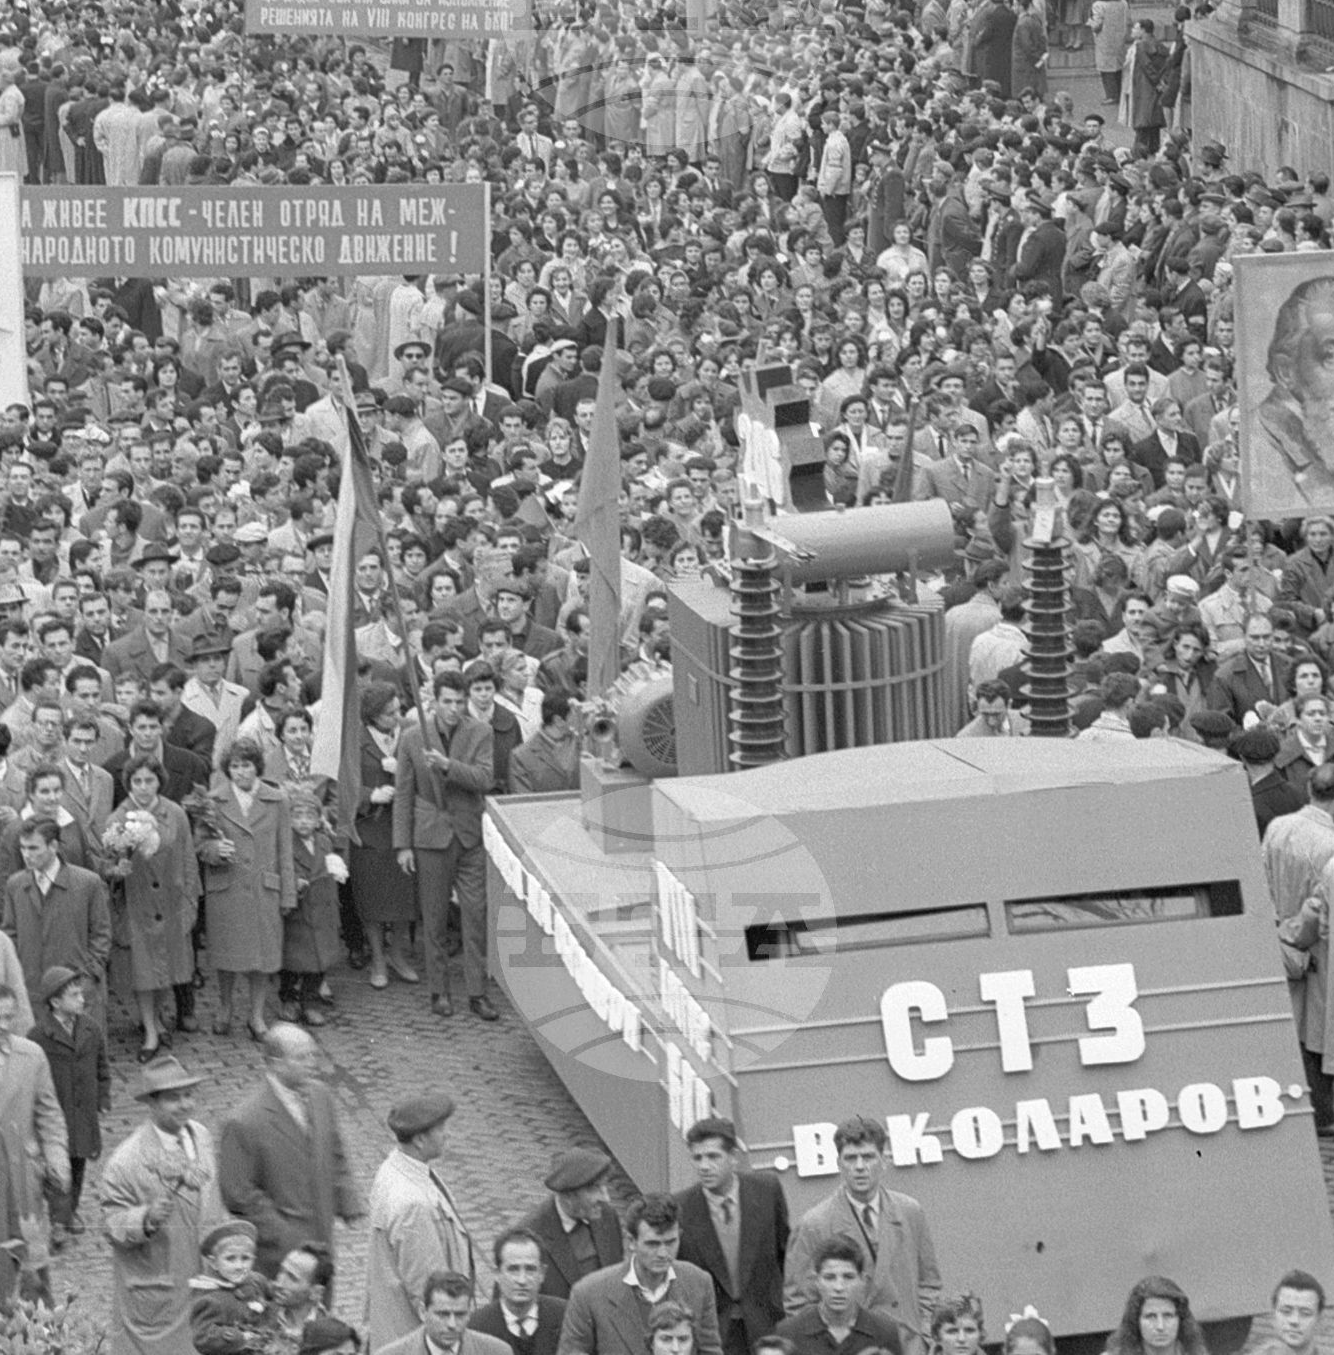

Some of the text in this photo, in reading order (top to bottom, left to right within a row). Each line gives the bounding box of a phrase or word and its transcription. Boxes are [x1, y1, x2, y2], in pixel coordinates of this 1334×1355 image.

[341, 9, 359, 28] НА
[397, 11, 456, 31] КОНГРЕС
[462, 12, 479, 31] НА
[42, 198, 108, 229] ЖИВЕЕ
[122, 196, 182, 229] КПСС
[279, 198, 346, 228] ОТРЯД
[356, 197, 384, 227] НА
[149, 234, 326, 265] КОМУНИСТИЧЕСКО
[337, 232, 438, 265] ДВИЖЕНИЕ
[879, 963, 1147, 1081] СТЗ
[885, 1075, 1286, 1167] КОЛАРОВ
